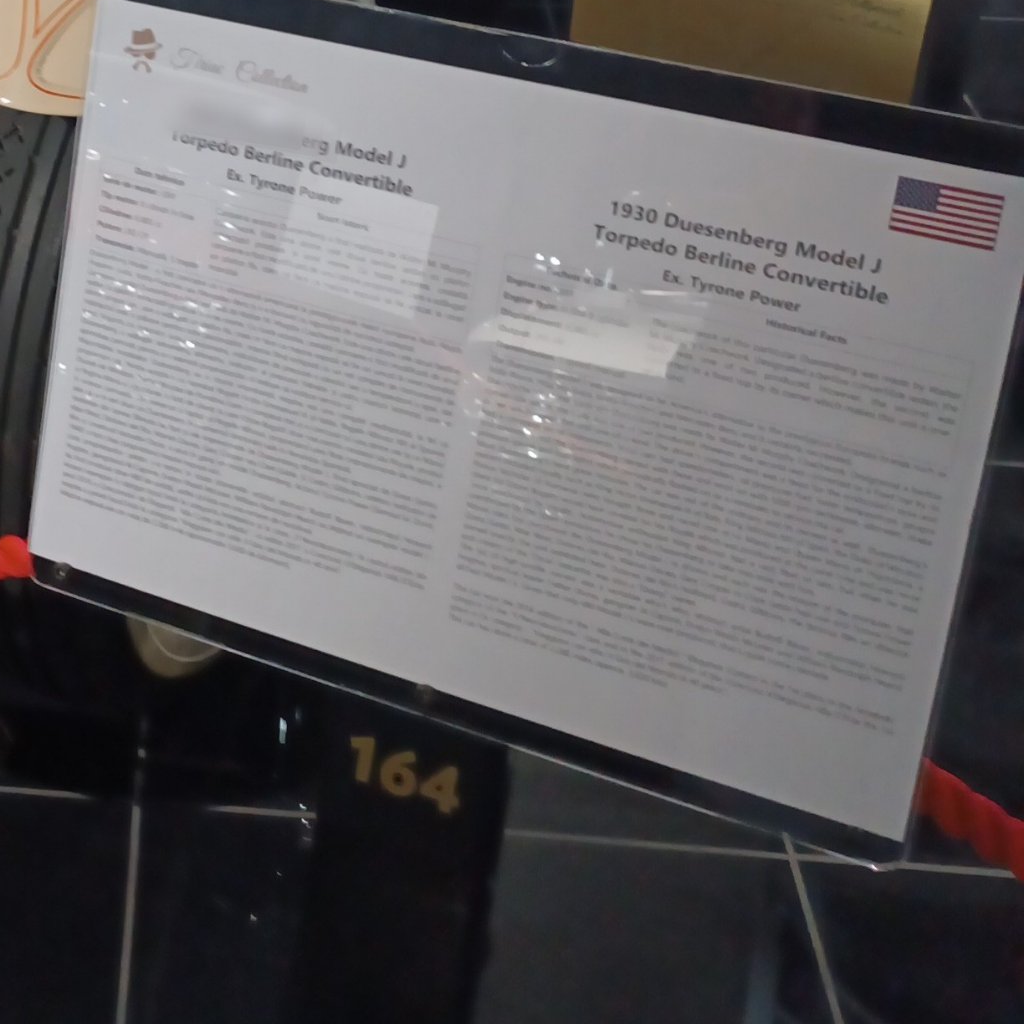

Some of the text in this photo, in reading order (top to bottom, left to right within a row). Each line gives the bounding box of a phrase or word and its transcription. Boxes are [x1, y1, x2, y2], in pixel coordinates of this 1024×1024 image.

[243, 146, 305, 172] Berline
[308, 161, 414, 198] Convertible
[334, 140, 393, 166] Model
[397, 153, 407, 169] J
[249, 174, 296, 195] Tyrone
[298, 185, 343, 205] Power
[610, 200, 882, 274] 1930 Duesenberg Model J
[593, 224, 890, 305] Torpedo Berline Convertible
[661, 270, 802, 313] Ex. Tyrone Power
[350, 736, 460, 814] 164
